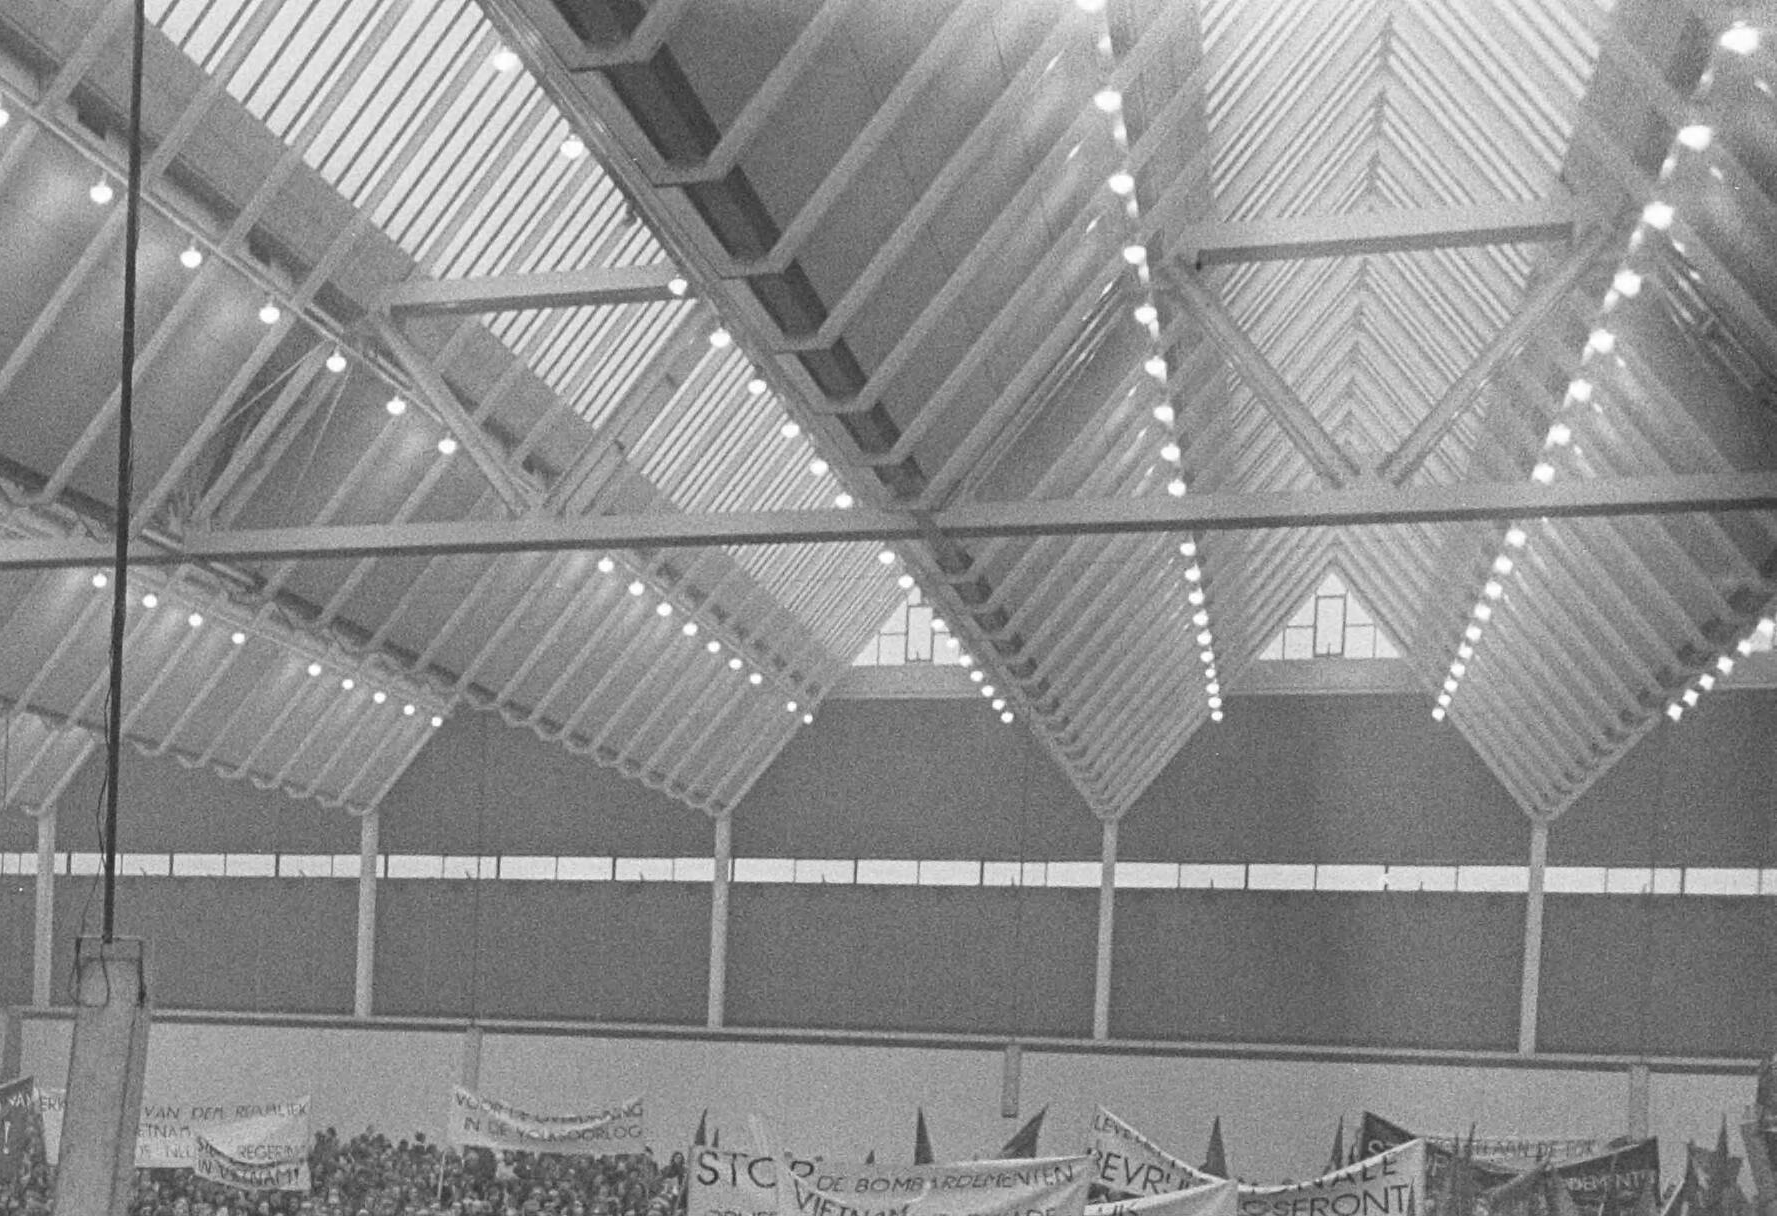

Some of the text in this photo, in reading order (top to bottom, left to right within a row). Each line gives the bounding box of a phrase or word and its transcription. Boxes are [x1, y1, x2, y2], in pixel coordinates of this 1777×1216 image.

[143, 1105, 181, 1119] VAN
[816, 1174, 844, 1192] DE
[854, 1164, 1073, 1194] BOMBARDEMENTEN
